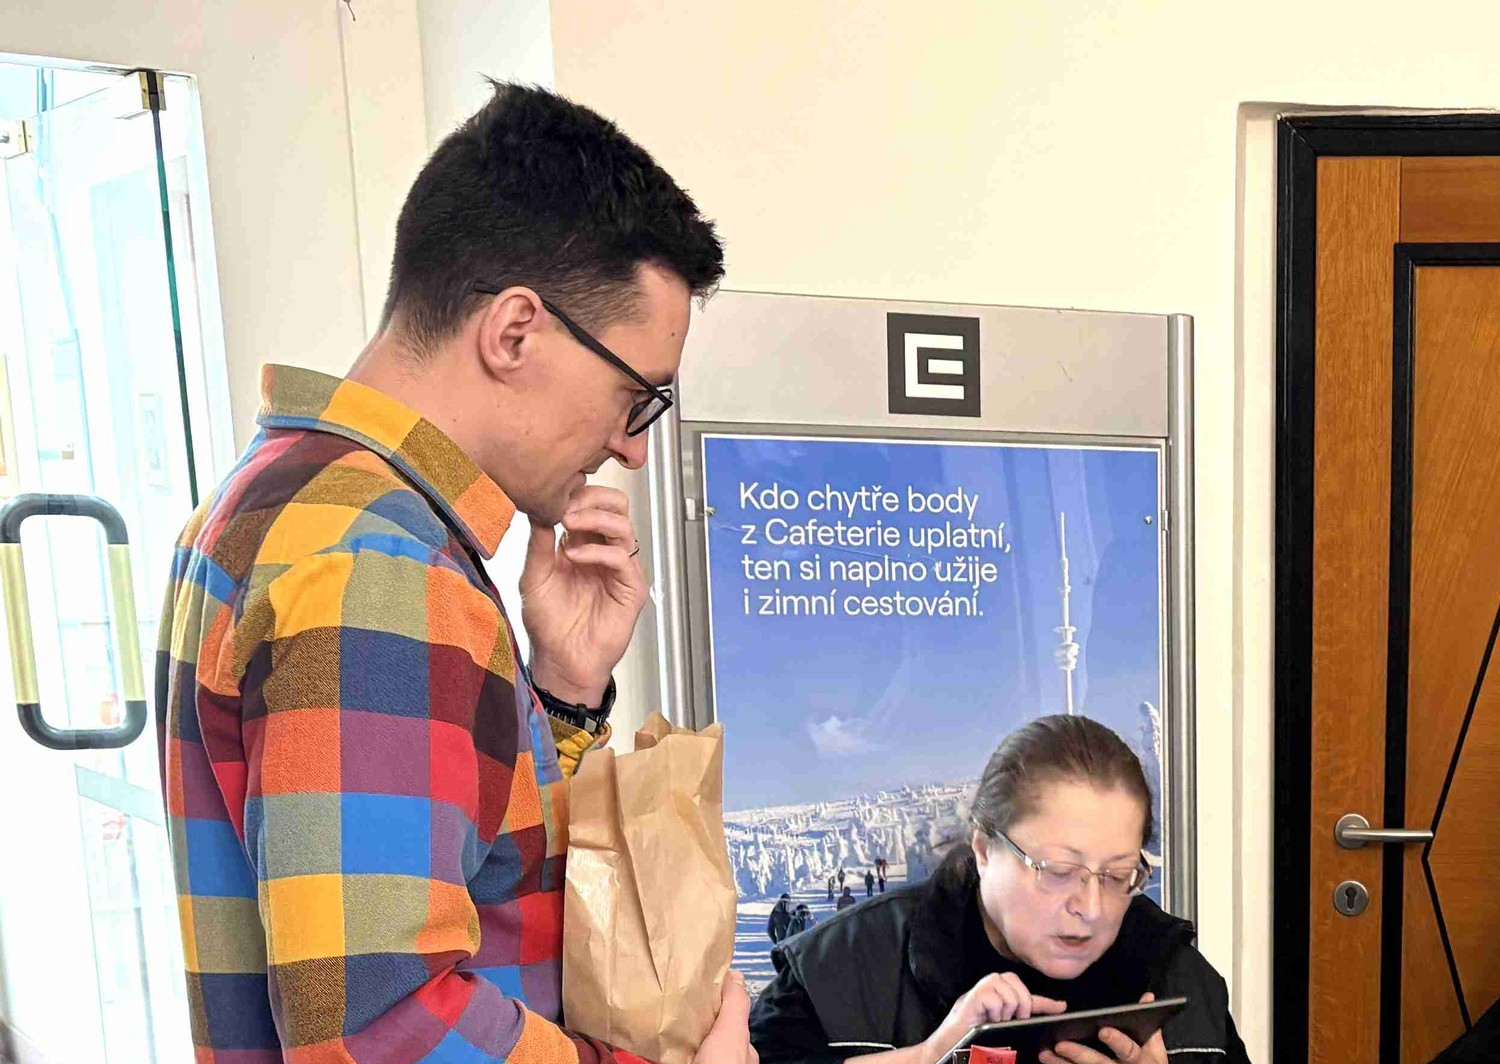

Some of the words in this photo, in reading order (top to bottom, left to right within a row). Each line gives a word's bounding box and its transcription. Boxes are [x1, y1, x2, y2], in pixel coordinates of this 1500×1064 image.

[739, 482, 799, 511] Kdo
[807, 484, 900, 518] chytře
[908, 487, 979, 521] body
[741, 525, 757, 545] z
[765, 517, 901, 547] Cafeterie
[909, 520, 1012, 554] uplatní,
[743, 556, 790, 580] ten
[800, 555, 821, 581] si
[830, 556, 927, 587] naplno
[934, 557, 997, 589] užije
[744, 589, 750, 616] i
[758, 588, 836, 616] zimní
[843, 590, 985, 618] cestování.
